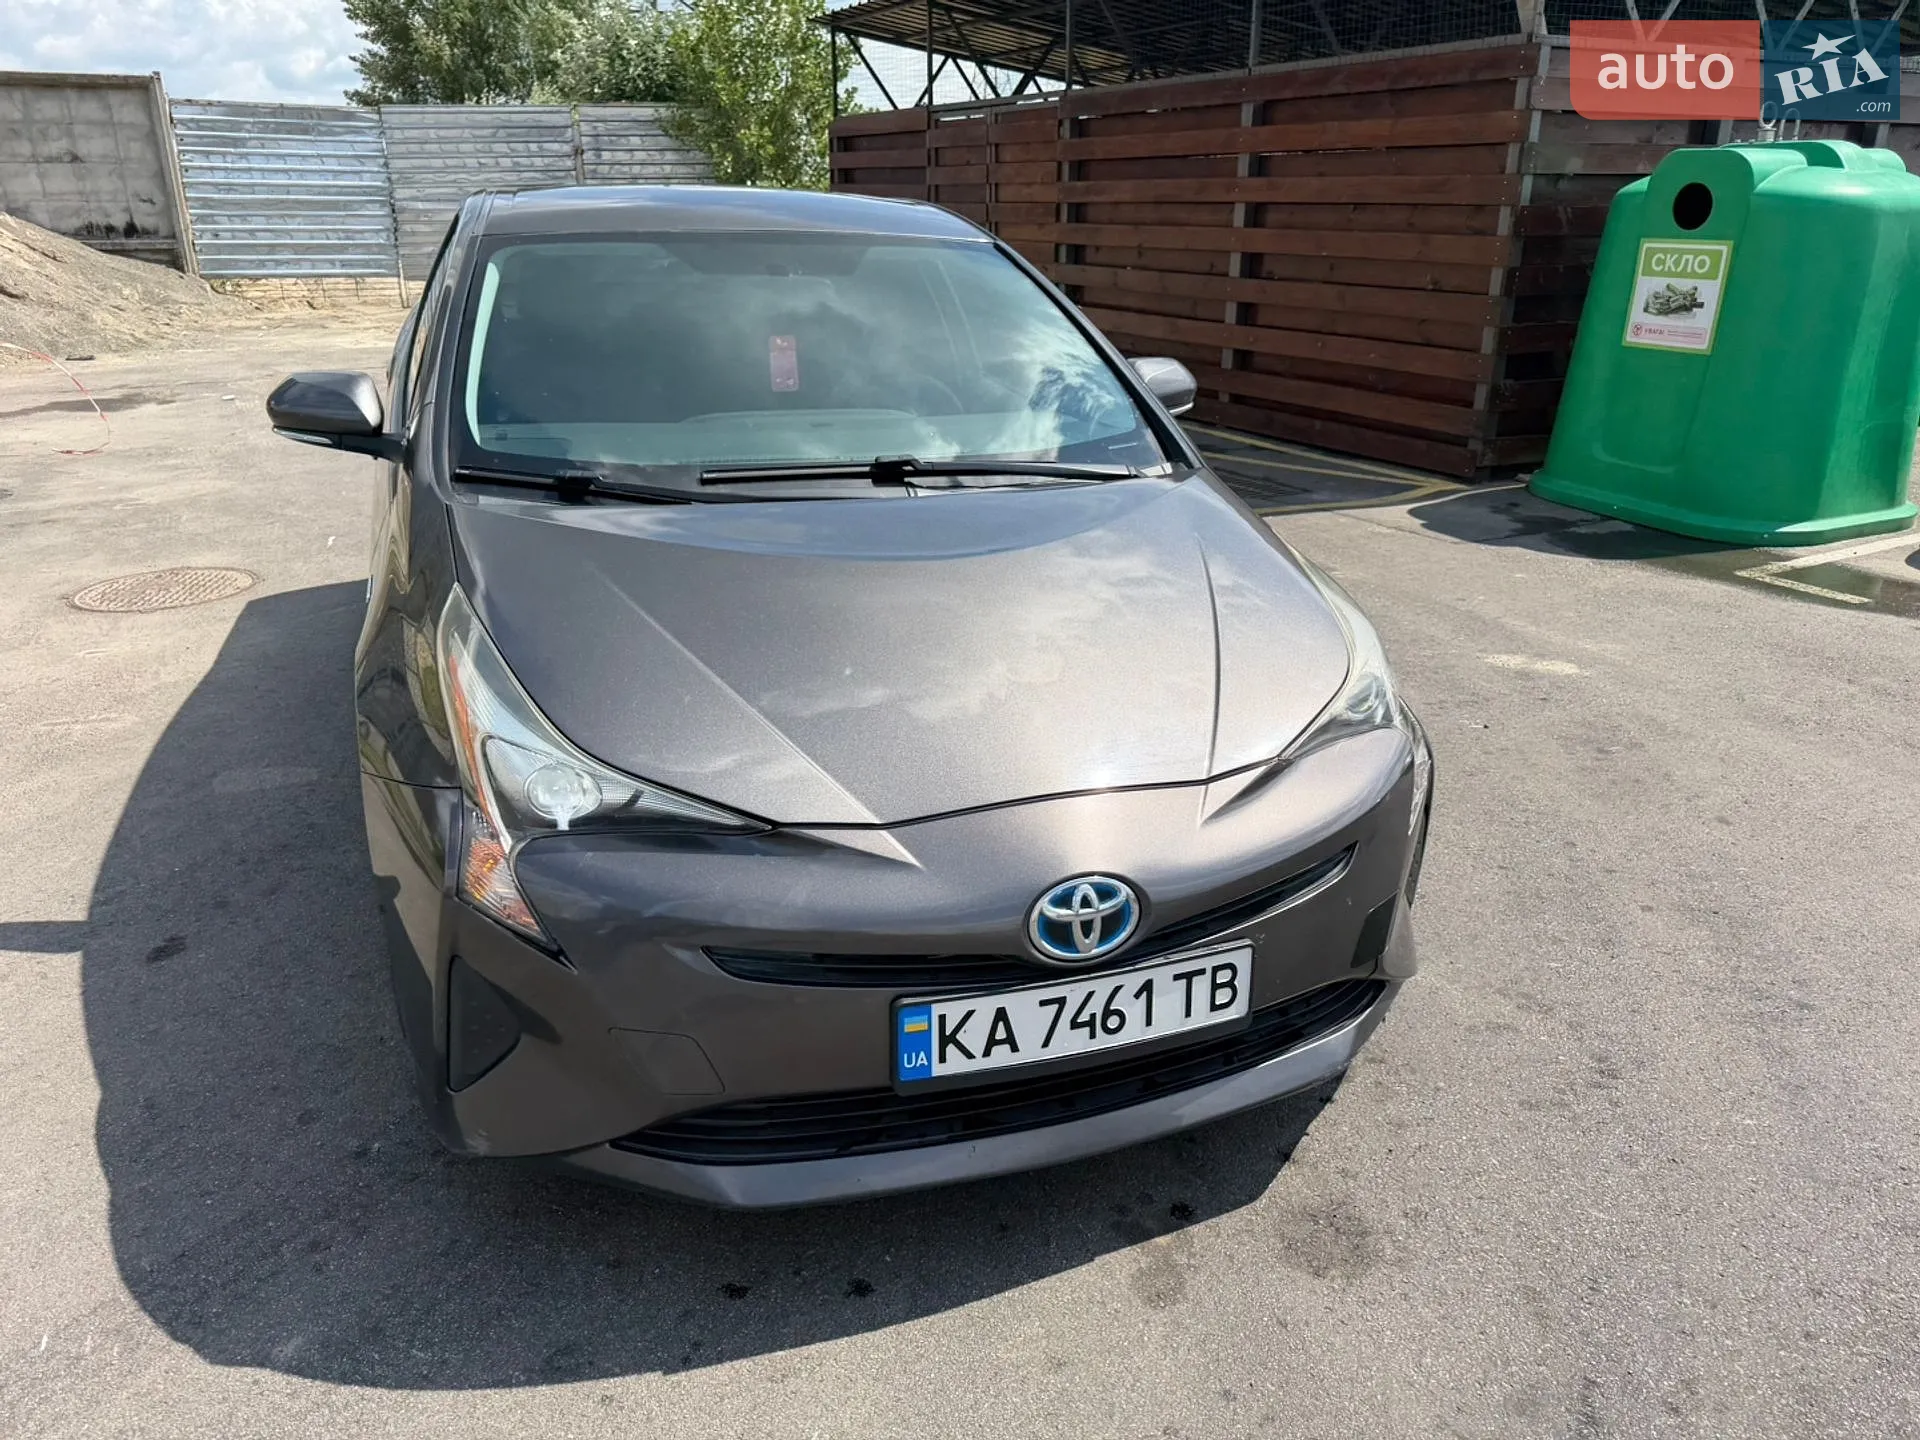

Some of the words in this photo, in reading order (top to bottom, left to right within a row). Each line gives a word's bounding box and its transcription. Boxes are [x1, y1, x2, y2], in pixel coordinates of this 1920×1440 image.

[1651, 253, 1711, 274] СКЛО
[938, 1006, 1020, 1064] KA
[1039, 979, 1155, 1049] 7461
[1173, 962, 1239, 1019] TB
[904, 1053, 928, 1068] UA
